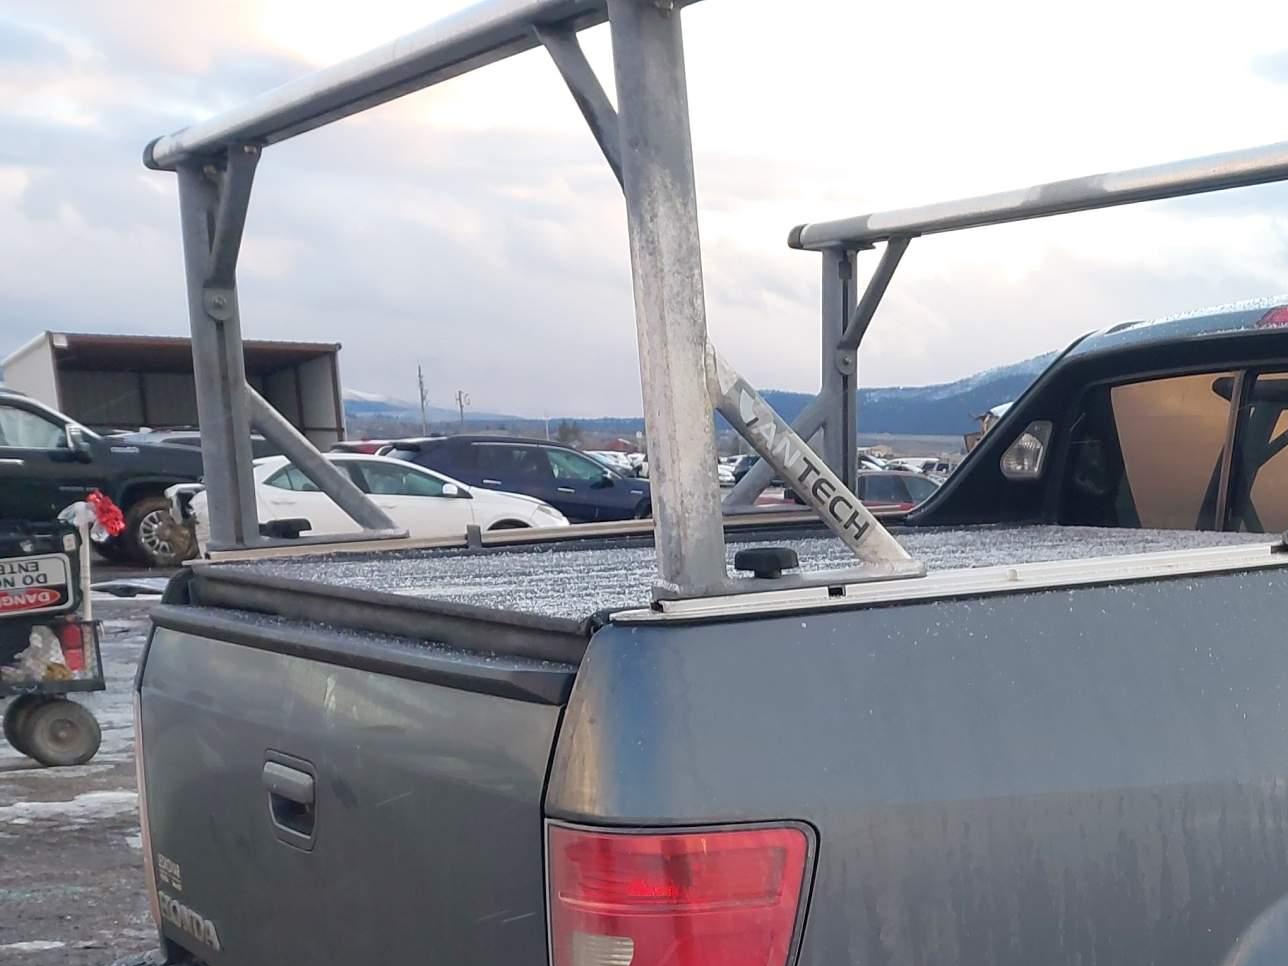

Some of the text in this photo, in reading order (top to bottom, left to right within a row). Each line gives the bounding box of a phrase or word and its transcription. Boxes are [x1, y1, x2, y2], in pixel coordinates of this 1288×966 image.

[739, 389, 869, 540] VANTECH
[22, 573, 47, 586] DO
[0, 591, 50, 608] DANG
